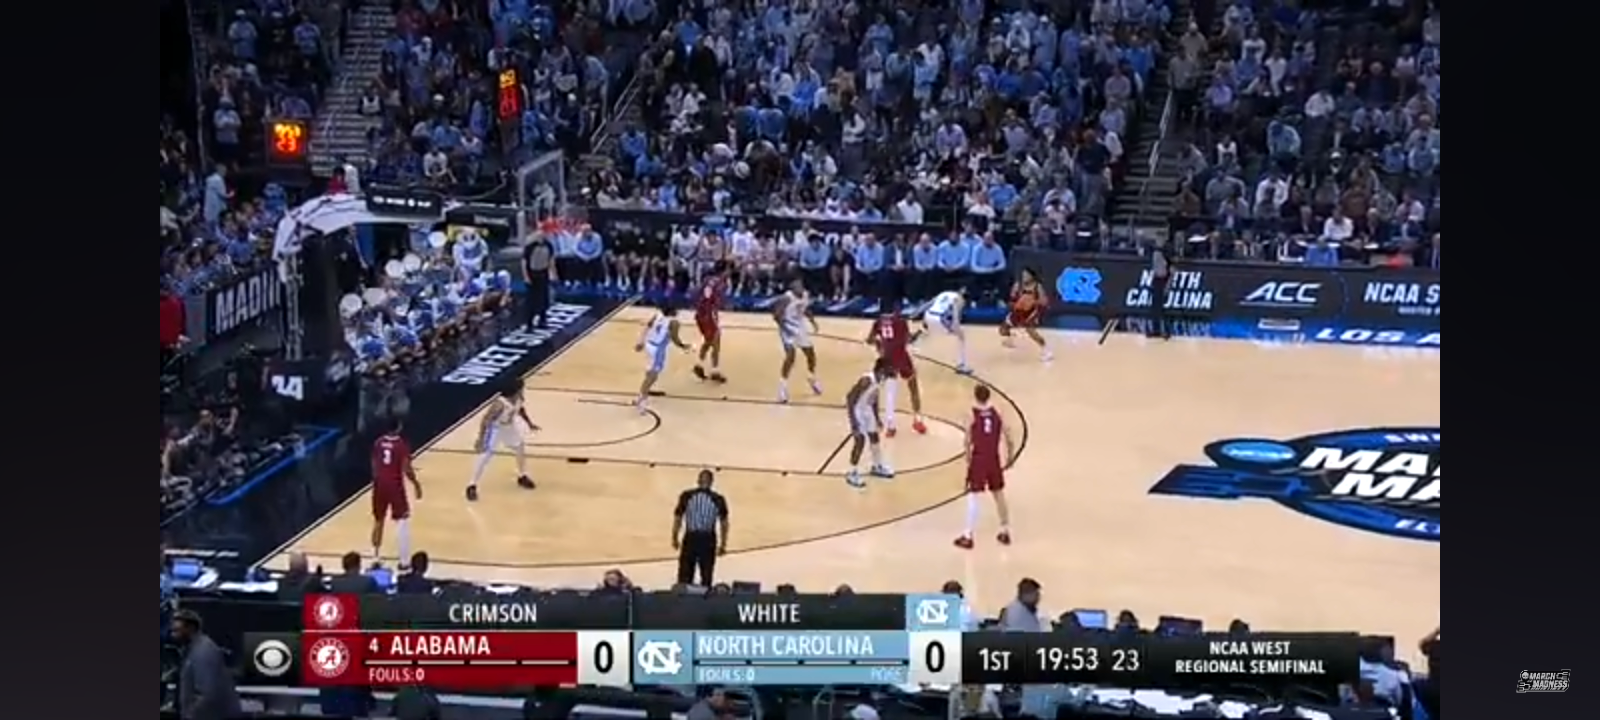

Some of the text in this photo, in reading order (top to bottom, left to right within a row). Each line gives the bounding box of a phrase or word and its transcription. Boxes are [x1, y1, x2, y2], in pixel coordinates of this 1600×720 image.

[1245, 281, 1323, 303] ACC
[1363, 282, 1420, 304] NCAA
[1314, 327, 1407, 344] LOS
